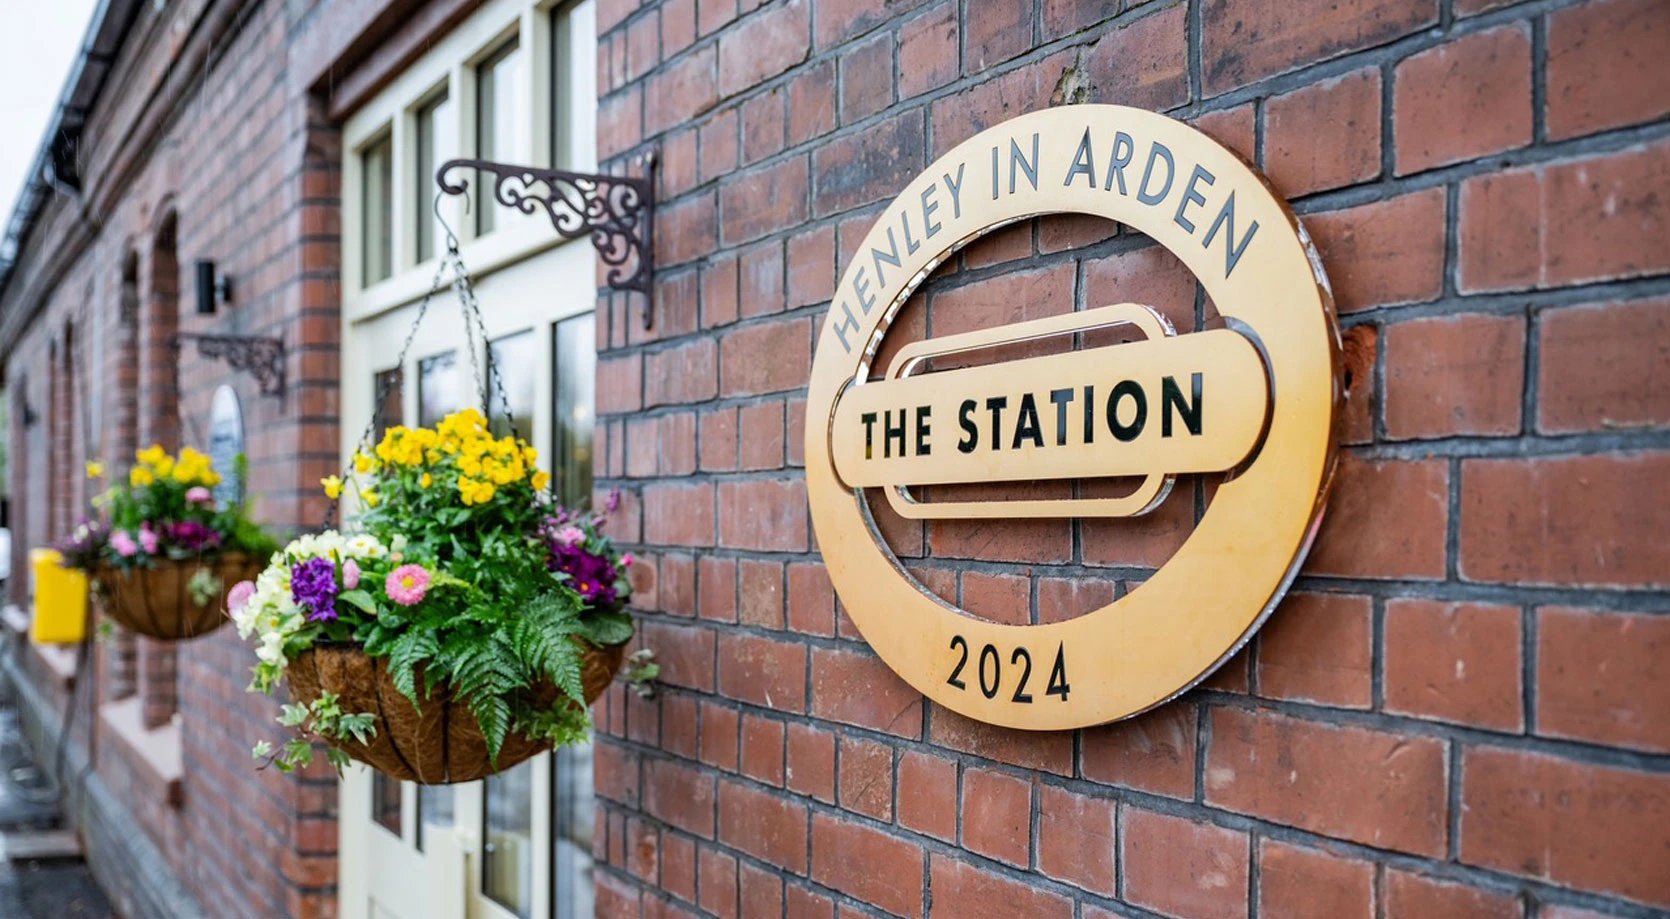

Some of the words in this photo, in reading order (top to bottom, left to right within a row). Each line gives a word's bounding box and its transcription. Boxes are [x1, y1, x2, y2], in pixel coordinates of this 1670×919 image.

[833, 163, 966, 354] HENLEY
[992, 133, 1040, 200] IN
[1063, 125, 1260, 280] ARDEN
[861, 405, 932, 460] THE
[957, 372, 1203, 454] STATION
[946, 634, 1071, 704] 2024
